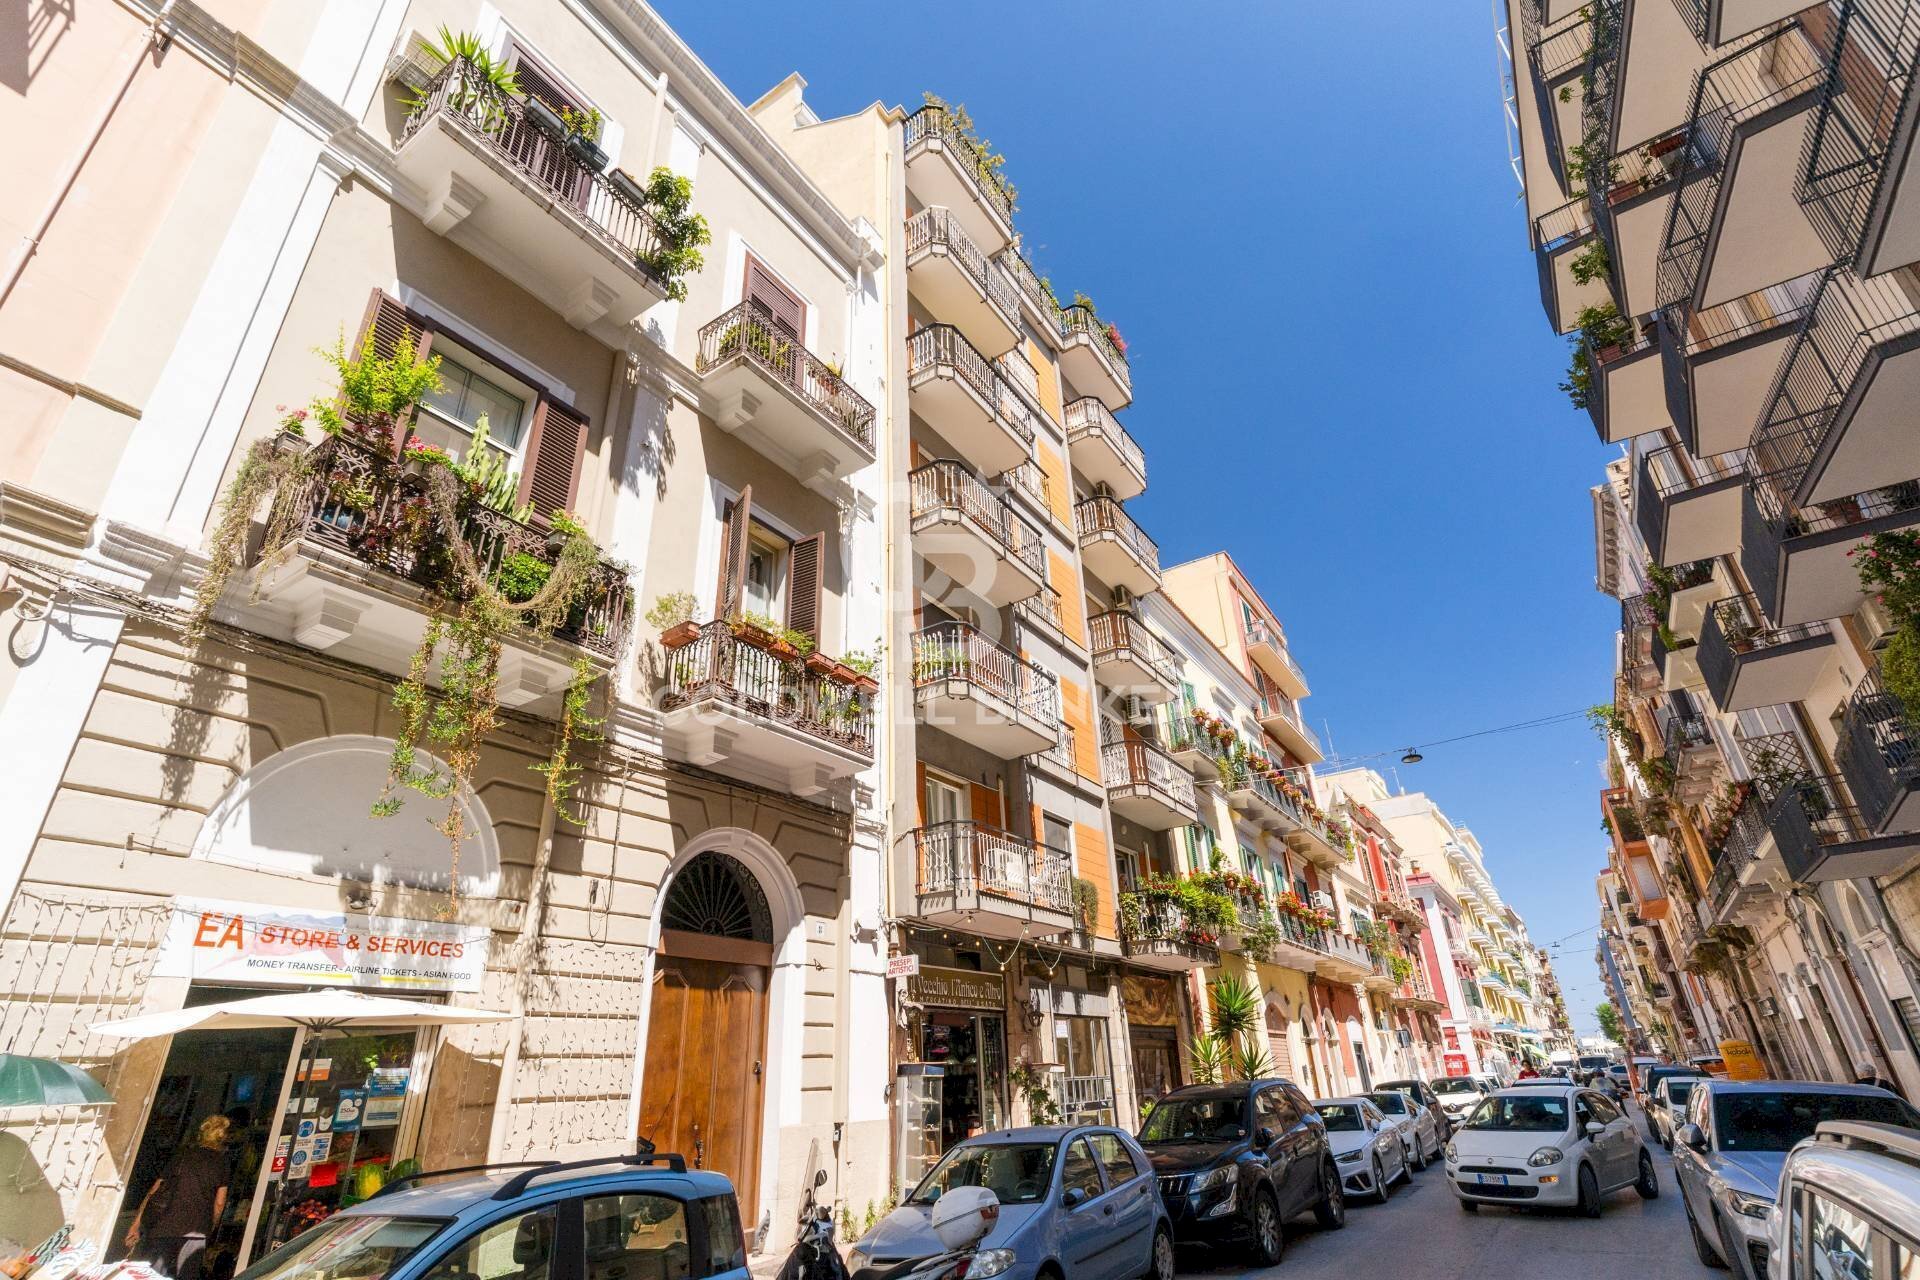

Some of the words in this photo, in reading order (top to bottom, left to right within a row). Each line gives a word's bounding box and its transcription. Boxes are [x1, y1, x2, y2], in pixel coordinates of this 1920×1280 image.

[193, 912, 244, 950] EA
[260, 925, 339, 949] STORE
[346, 934, 360, 950] &
[367, 936, 464, 958] SERVICES
[247, 959, 284, 969] MONEY
[287, 961, 338, 972] TRANSFER
[345, 966, 380, 974] AIRLINE
[382, 968, 417, 977] TICKETS
[423, 970, 448, 979] ASIAN
[449, 972, 471, 980] FOOD
